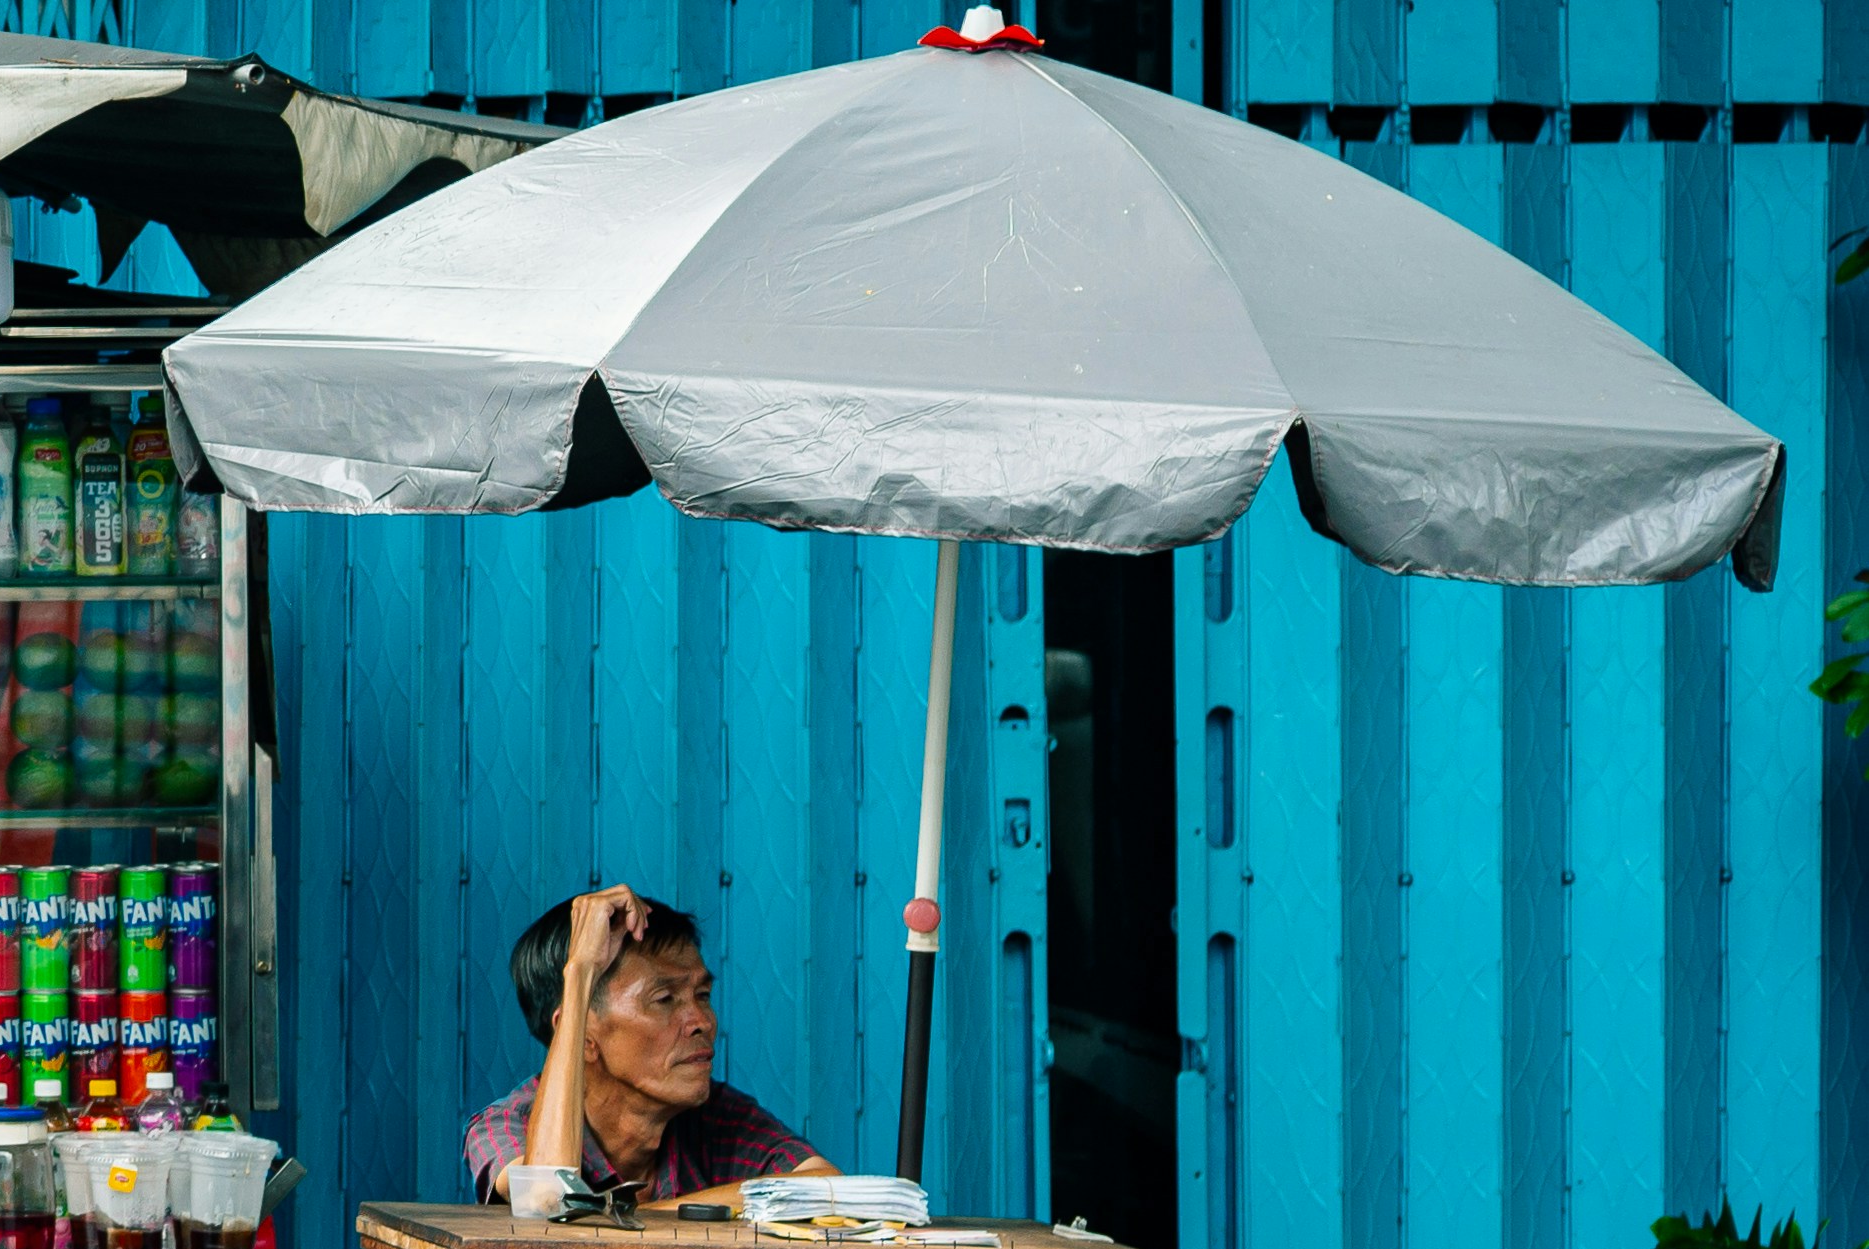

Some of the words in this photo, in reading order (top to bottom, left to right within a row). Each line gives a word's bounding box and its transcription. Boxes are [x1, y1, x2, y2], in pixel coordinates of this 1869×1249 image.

[85, 481, 117, 495] TEA
[21, 895, 69, 924] FANT
[70, 895, 117, 924] FANT
[22, 1018, 69, 1046] FANT
[70, 1017, 117, 1046] FANT
[121, 1017, 167, 1045] FANT
[170, 1017, 217, 1045] FANT
